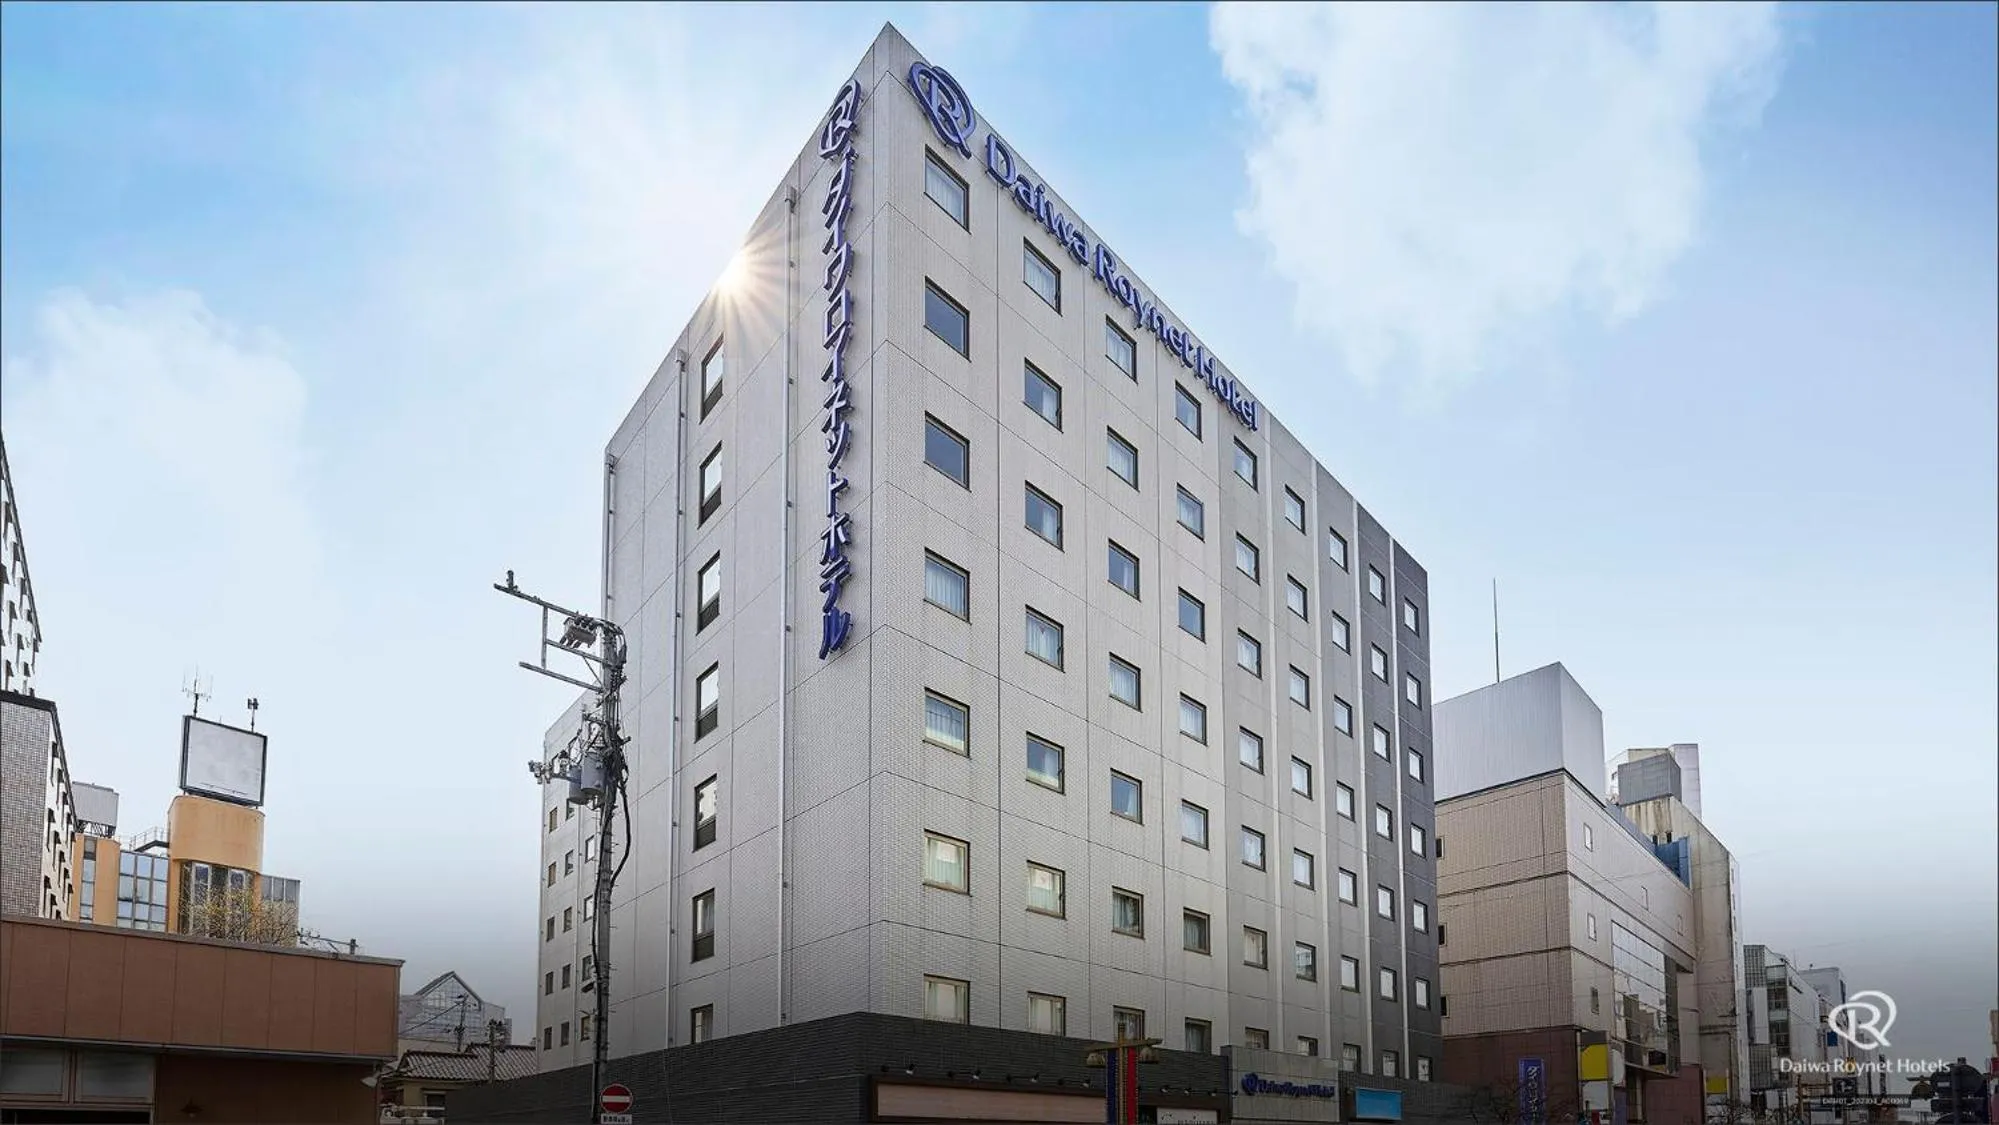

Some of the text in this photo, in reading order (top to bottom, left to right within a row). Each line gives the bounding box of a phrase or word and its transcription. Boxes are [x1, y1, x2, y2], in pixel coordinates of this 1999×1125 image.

[819, 146, 856, 660] ダイワロイネットホテル
[986, 134, 1090, 267] Daiwa
[1095, 244, 1195, 369] Roynet
[1195, 353, 1260, 431] Hotel
